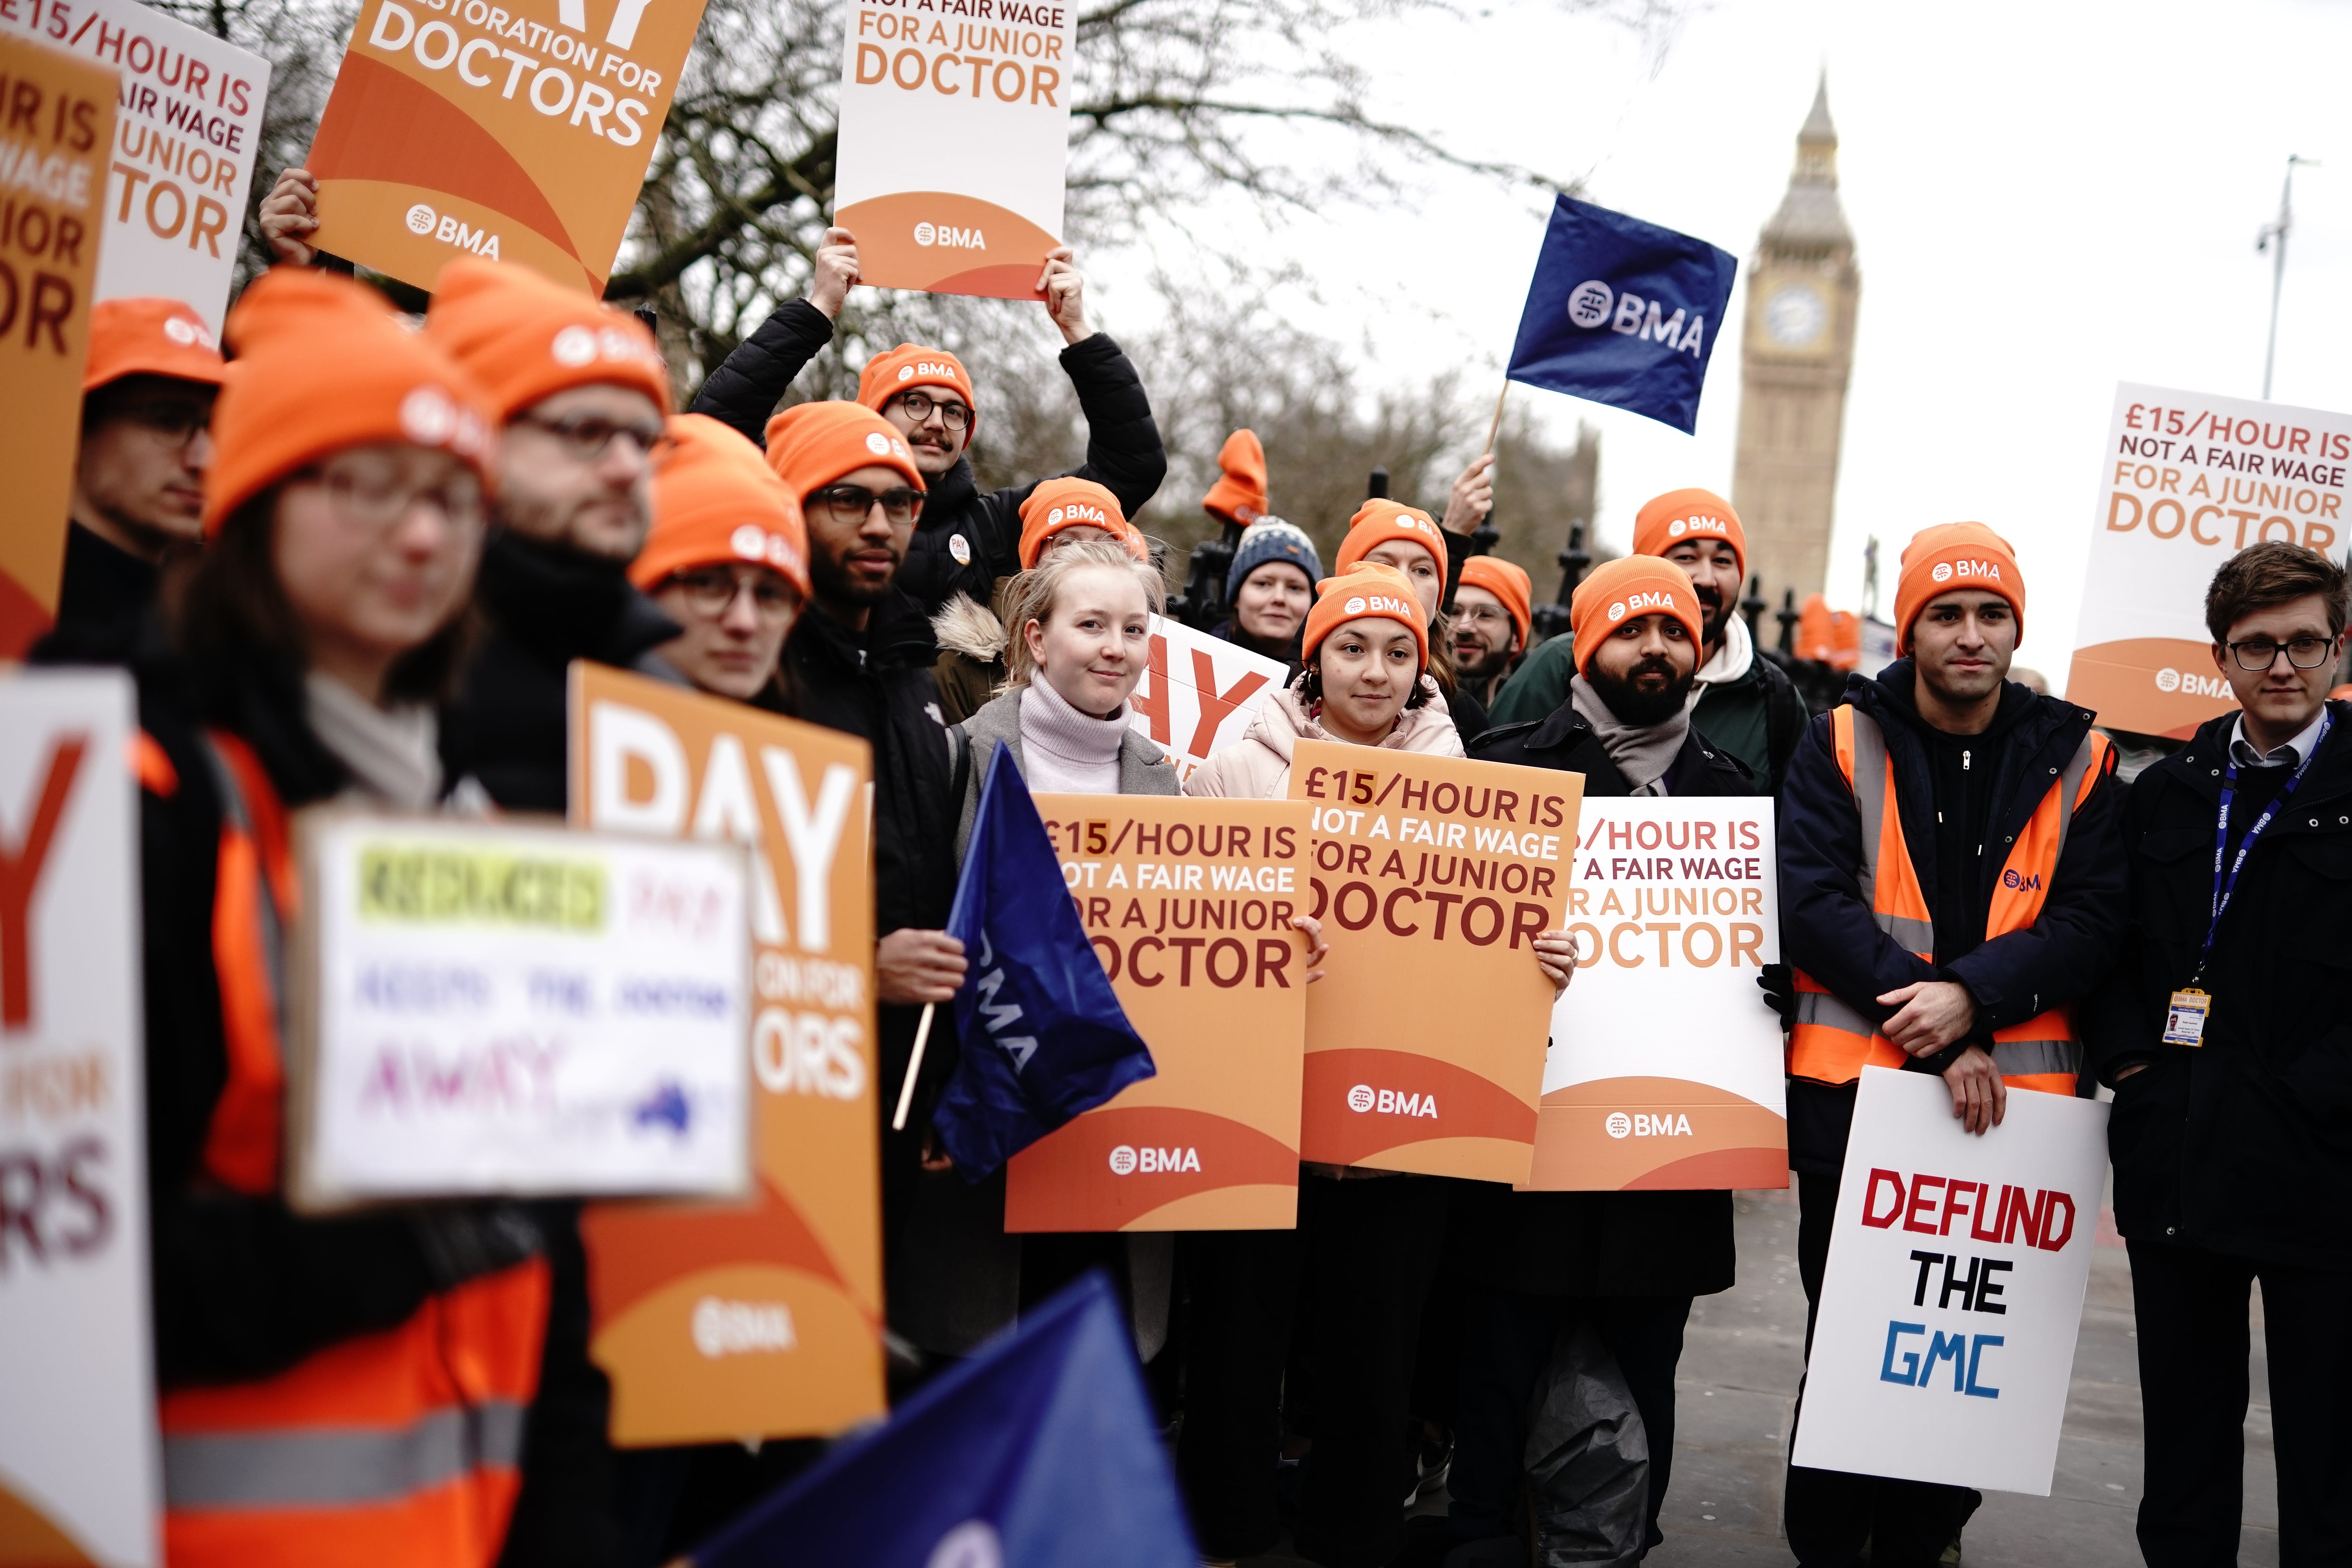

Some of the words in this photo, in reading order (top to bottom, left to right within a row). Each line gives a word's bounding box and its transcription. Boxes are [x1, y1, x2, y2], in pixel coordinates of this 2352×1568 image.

[858, 9, 920, 42] FOR
[927, 20, 948, 46] A
[953, 23, 1063, 61] JUNIOR
[999, 0, 1065, 29] WAGE
[369, 0, 649, 146] DOCTORS
[600, 53, 661, 97] FOR
[855, 42, 1060, 107] DOCTOR
[219, 73, 252, 117] IS
[53, 94, 97, 152] IS
[119, 80, 157, 118] IR
[165, 96, 244, 154] WAGE
[120, 117, 237, 197] UNIOR
[0, 198, 85, 267] IOR
[112, 163, 227, 260] TOR
[436, 215, 500, 261] BMA
[938, 225, 986, 250] BMA
[1611, 292, 1704, 358] BMA
[917, 362, 956, 379] BMA
[2125, 403, 2311, 454] £15/HOUR
[2319, 432, 2351, 461] IS
[2119, 435, 2176, 460] NOT
[2179, 445, 2198, 465] A
[2207, 448, 2264, 474] FAIR
[2272, 457, 2346, 488] WAGE
[2114, 461, 2181, 494] FOR
[2188, 473, 2211, 499] A
[2217, 477, 2342, 519] JUNIOR
[1066, 504, 1105, 525] BMA
[1689, 515, 1726, 534] BMA
[2106, 491, 2336, 561] DOCTOR
[951, 538, 965, 549] PAY
[1957, 560, 2001, 581] BMA
[1369, 595, 1411, 619] BMA
[1629, 591, 1675, 610] BMA
[1128, 633, 1270, 759] AY
[2181, 673, 2234, 701] BMA
[2318, 728, 2328, 743] BMA
[2295, 764, 2307, 779] BMA
[1305, 766, 1519, 822] £15/HOUR
[1530, 794, 1566, 828] IS
[2220, 804, 2229, 821] BMA
[1045, 818, 1252, 857] £15/HOUR
[1264, 826, 1296, 858] IS
[1368, 814, 1391, 840] A
[1399, 817, 1466, 849] FAIR
[1475, 826, 1561, 860] WAGE
[1575, 818, 1717, 851] /HOUR
[1728, 821, 1760, 850] IS
[2251, 818, 2267, 834] BMA
[1061, 861, 1101, 888] OT
[1106, 863, 1129, 889] A
[1137, 864, 1203, 891] FAIR
[1211, 866, 1295, 893] WAGE
[1379, 849, 1406, 880] A
[1412, 852, 1555, 898] JUNIOR
[1584, 858, 1604, 880] A
[1612, 858, 1673, 880] FAIR
[1680, 857, 1761, 880] WAGE
[2231, 857, 2243, 873] BMA
[1120, 898, 1147, 928] A
[1154, 898, 1293, 934] JUNIOR
[1599, 887, 1625, 915] A
[1632, 887, 1764, 920] JUNIOR
[2218, 900, 2227, 915] BMA
[1088, 935, 1291, 989] OCTOR
[1565, 922, 1764, 968] OCTOR
[1376, 1090, 1438, 1119] BMA
[1634, 1114, 1693, 1136] BMA
[1140, 1147, 1201, 1173] BMA
[1861, 1167, 2076, 1252] DEFUND
[1910, 1249, 2013, 1315] THE
[1880, 1320, 2004, 1399] GMC
